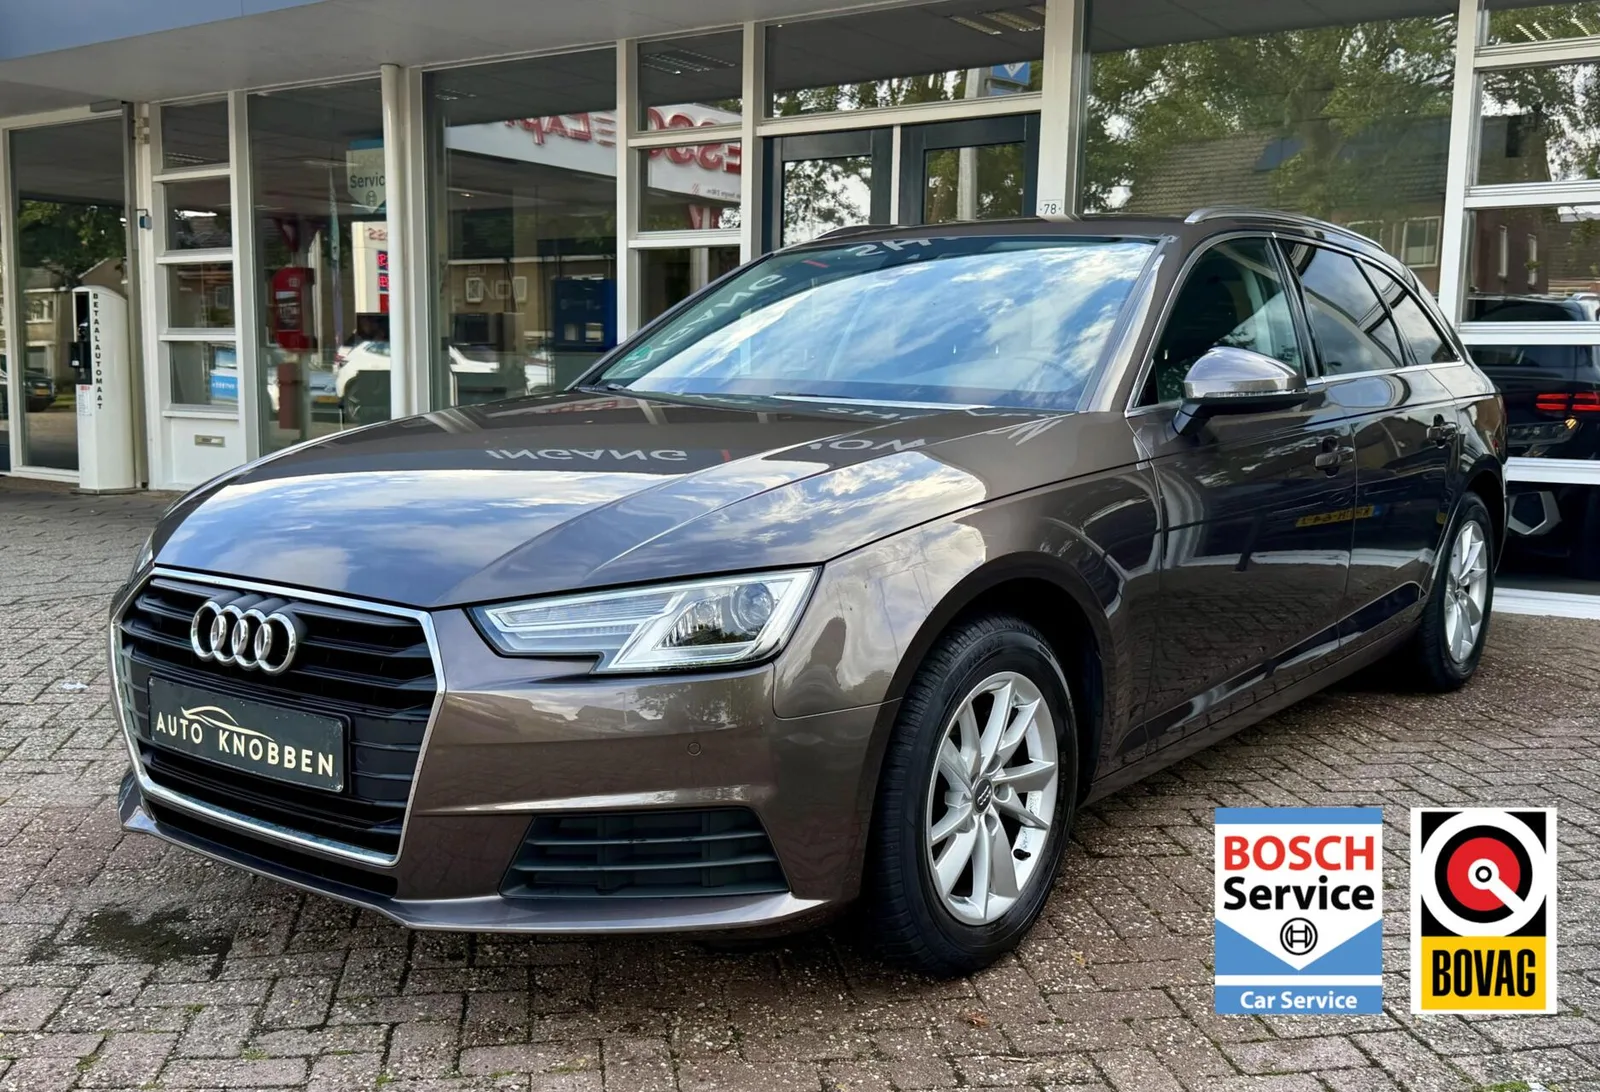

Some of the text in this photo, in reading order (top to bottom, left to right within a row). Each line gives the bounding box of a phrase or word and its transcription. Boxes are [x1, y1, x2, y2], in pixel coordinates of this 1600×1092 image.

[350, 172, 386, 189] Servic
[1044, 203, 1057, 215] 78
[92, 292, 103, 410] BETAALAUTOMAAT
[155, 711, 334, 777] AUTO KNOBBEN
